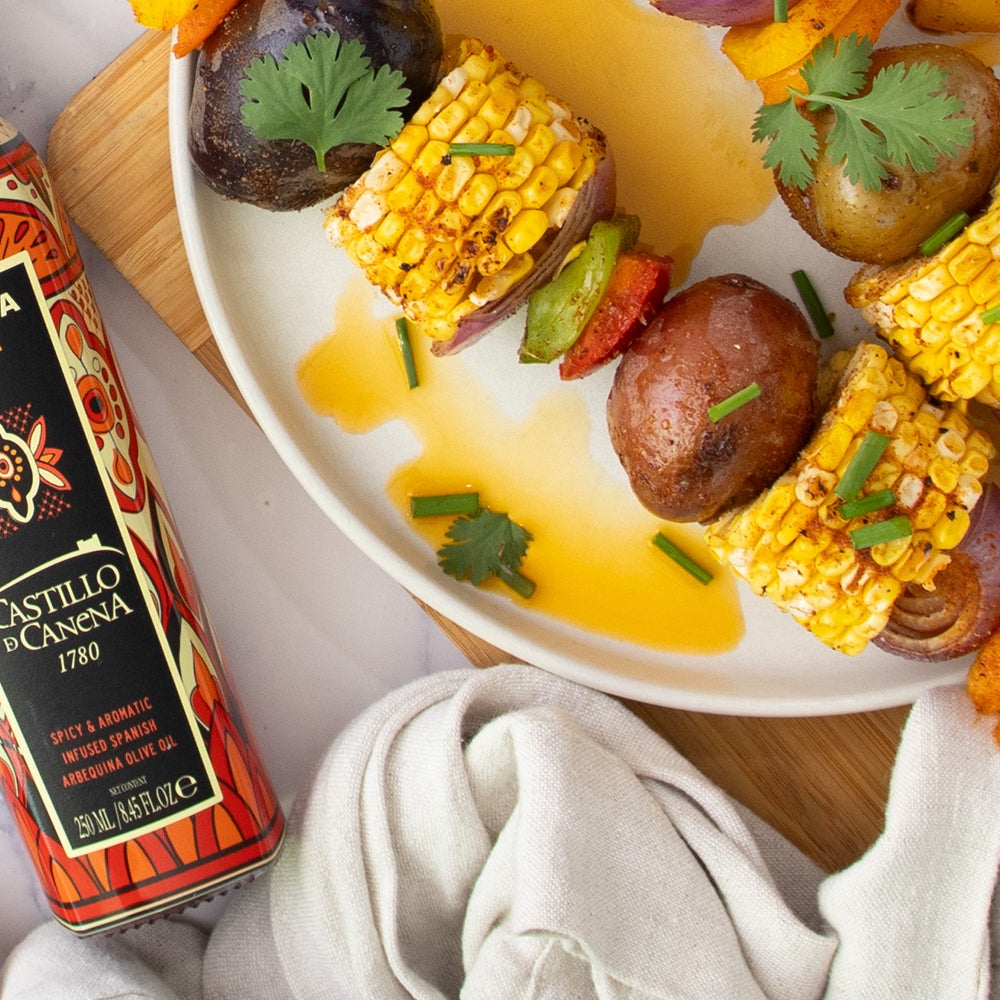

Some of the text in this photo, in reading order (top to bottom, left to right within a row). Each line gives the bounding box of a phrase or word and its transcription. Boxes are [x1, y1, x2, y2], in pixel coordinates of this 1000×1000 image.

[58, 641, 100, 673] 1780
[50, 697, 152, 745] SPICY & AROMATIC
[62, 718, 158, 765] INFUSED SPANISH
[62, 735, 178, 788] ARBEQUINA OLIVE OIL
[121, 775, 148, 793] CONTENT
[73, 813, 96, 839] 250
[91, 808, 116, 834] ML
